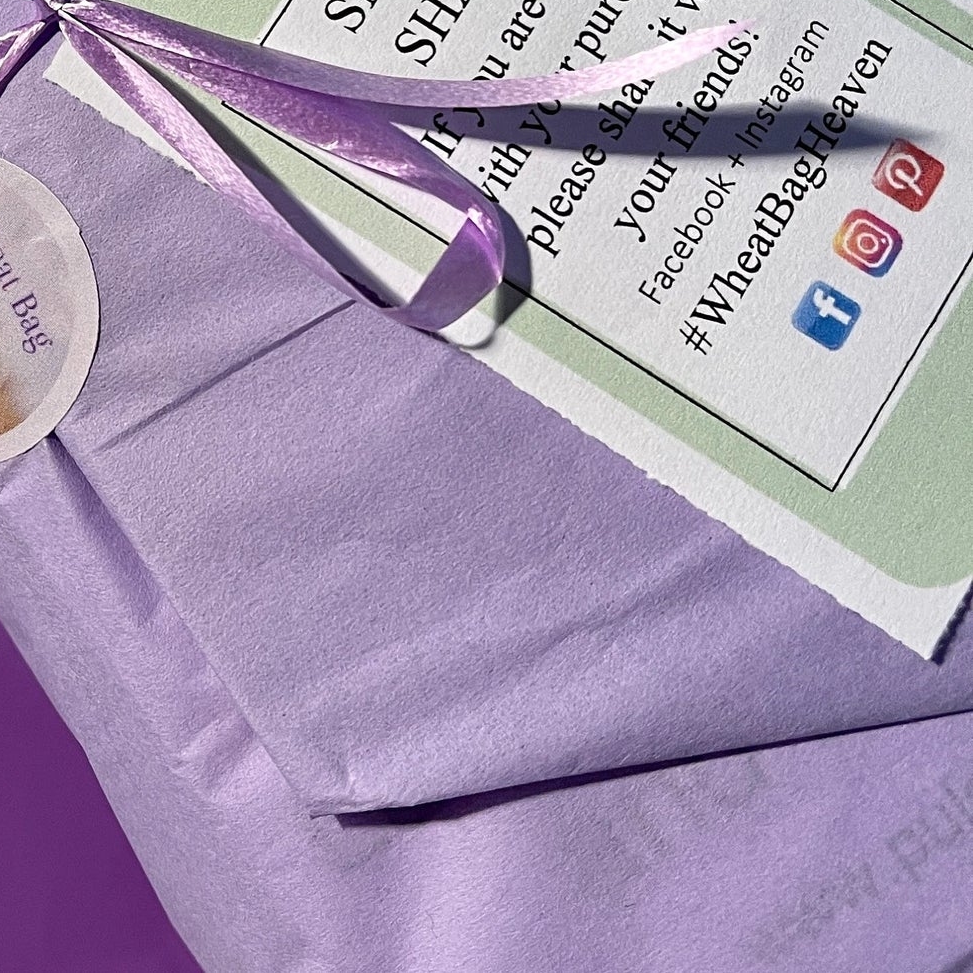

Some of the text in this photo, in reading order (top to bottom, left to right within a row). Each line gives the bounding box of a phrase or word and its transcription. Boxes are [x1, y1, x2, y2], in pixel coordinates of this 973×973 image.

[421, 112, 465, 158] If
[453, 54, 510, 128] yu
[527, 143, 606, 258] please
[647, 16, 687, 41] it
[638, 20, 829, 304] Facebook + Instagram
[613, 152, 677, 243] your
[679, 39, 893, 355] #WheatBagHeaven
[9, 292, 53, 355] Bag
